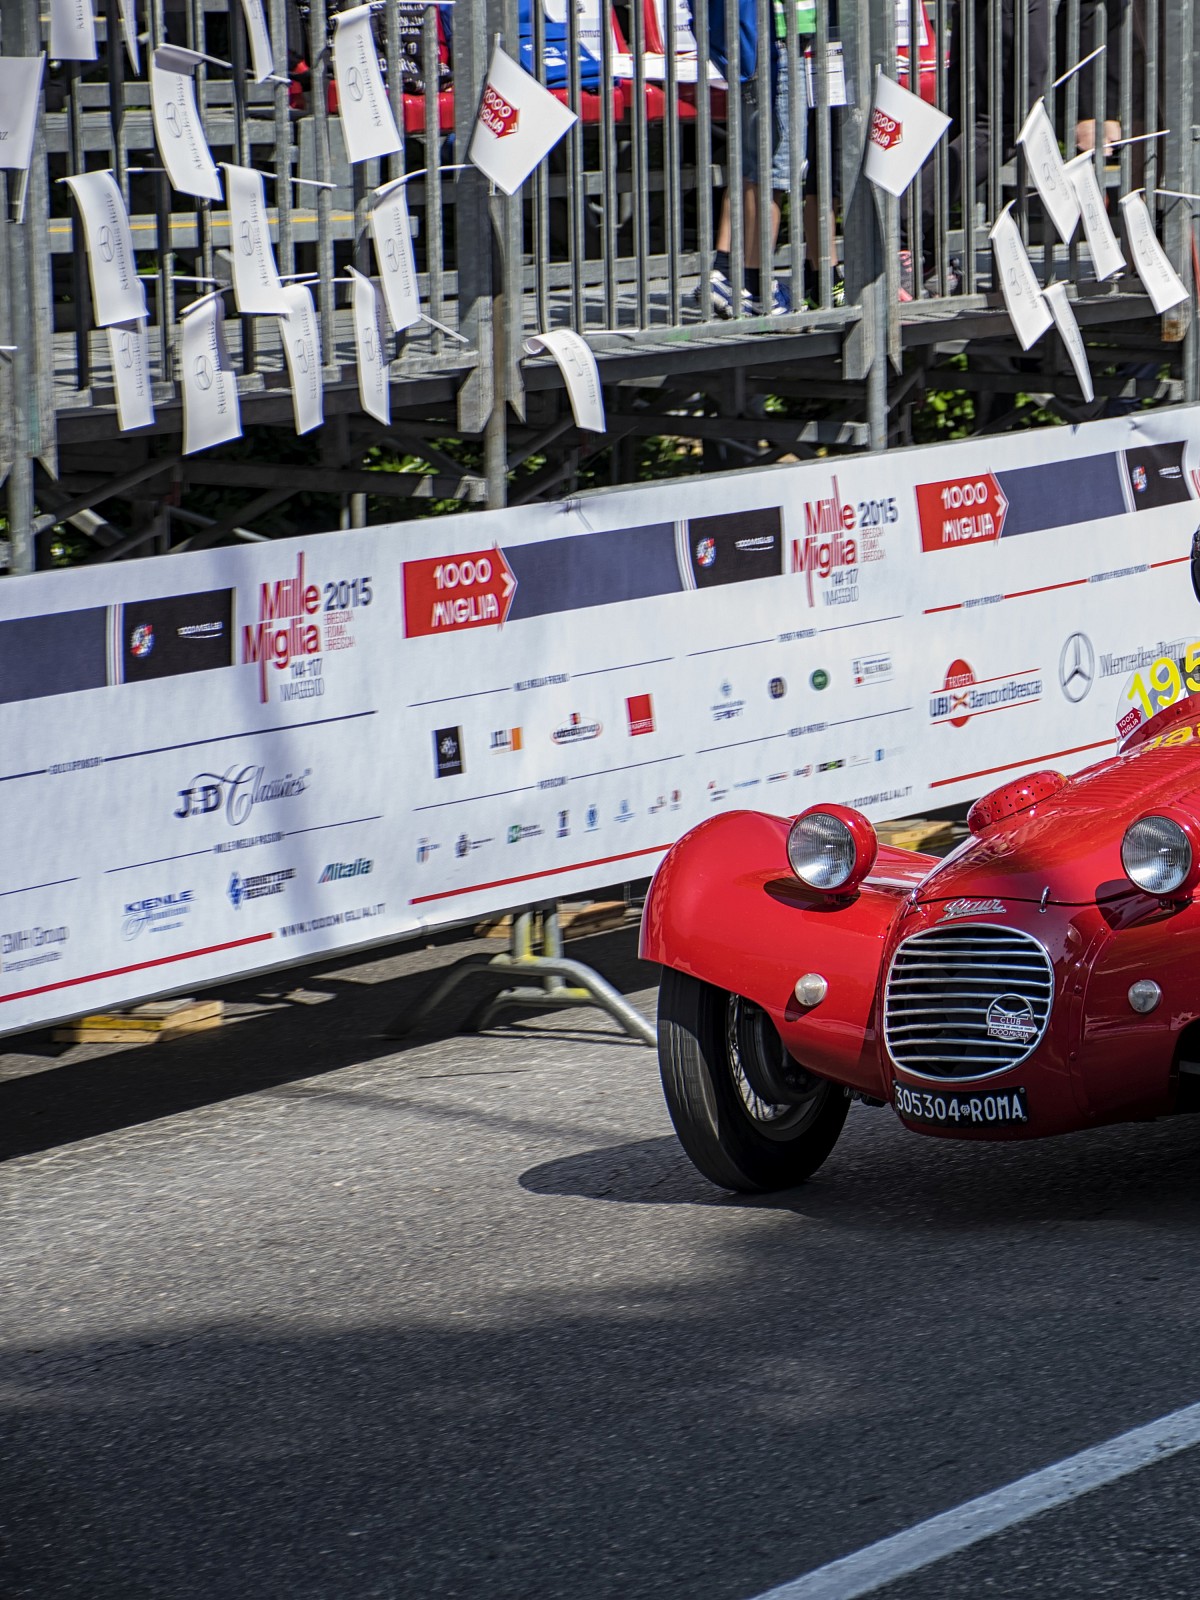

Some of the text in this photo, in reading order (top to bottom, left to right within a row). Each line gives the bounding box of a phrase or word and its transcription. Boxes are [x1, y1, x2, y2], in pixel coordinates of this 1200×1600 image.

[803, 475, 899, 536] Mille 2015
[940, 481, 989, 510] 1000
[941, 512, 995, 543] MIGLIA
[259, 551, 373, 622] Mille 2015
[433, 558, 492, 590] 1000
[431, 593, 499, 628] MIGLIA
[290, 658, 323, 680] 14-17
[1100, 641, 1186, 679] Mercedes-Benz
[929, 694, 952, 718] UBI
[1119, 713, 1135, 729] 1000
[1120, 718, 1140, 737] MIGLIA
[1000, 1017, 1021, 1025] CLUB
[895, 1085, 1023, 1122] 305304 ROMA
